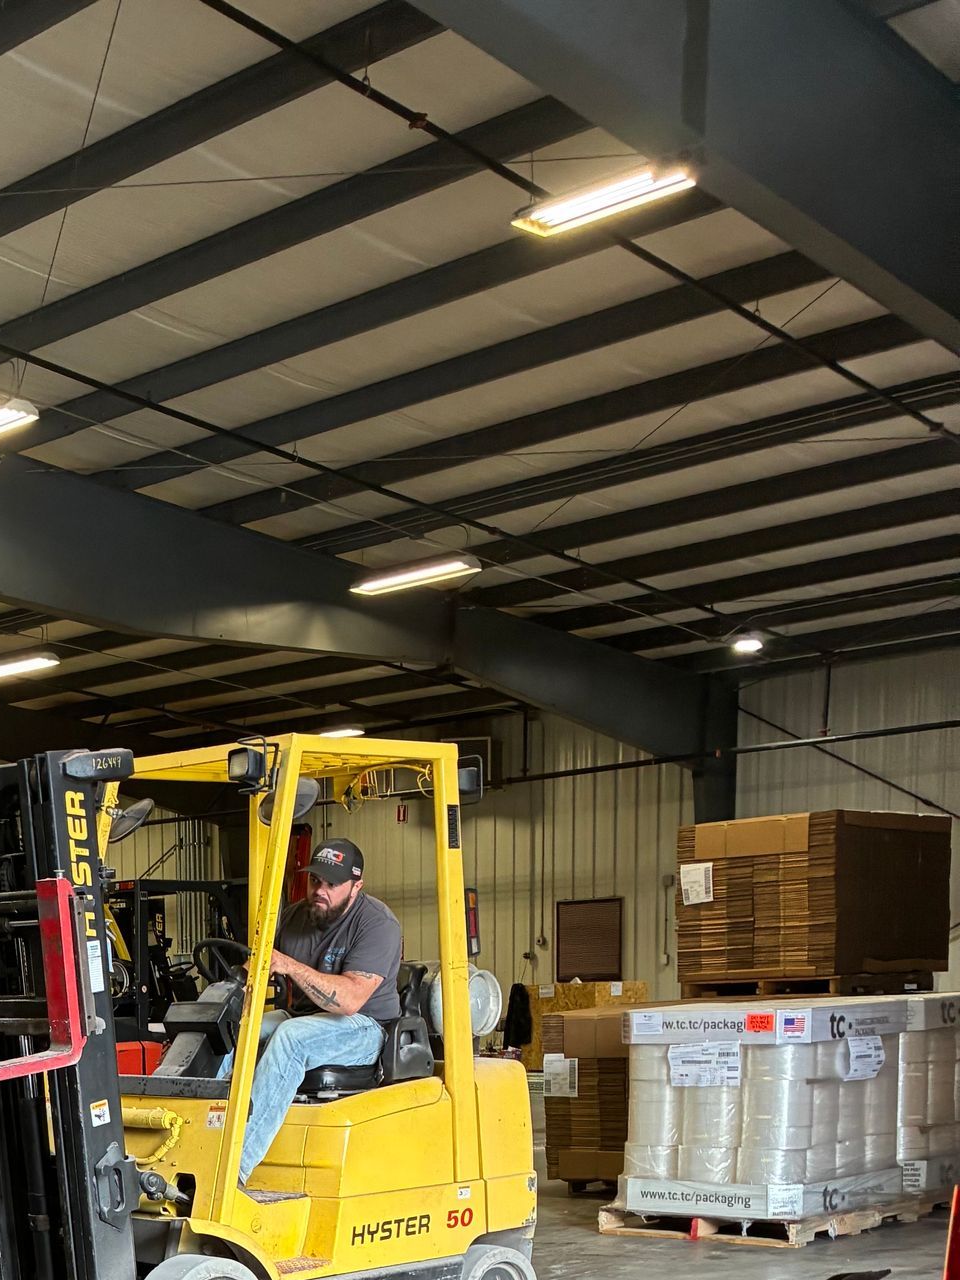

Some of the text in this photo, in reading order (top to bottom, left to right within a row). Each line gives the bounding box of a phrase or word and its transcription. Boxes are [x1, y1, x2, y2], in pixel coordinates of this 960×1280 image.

[65, 790, 97, 937] HSTER
[640, 1188, 751, 1209] www.tc.tc/packaging
[351, 1207, 474, 1246] HYSTER 50
